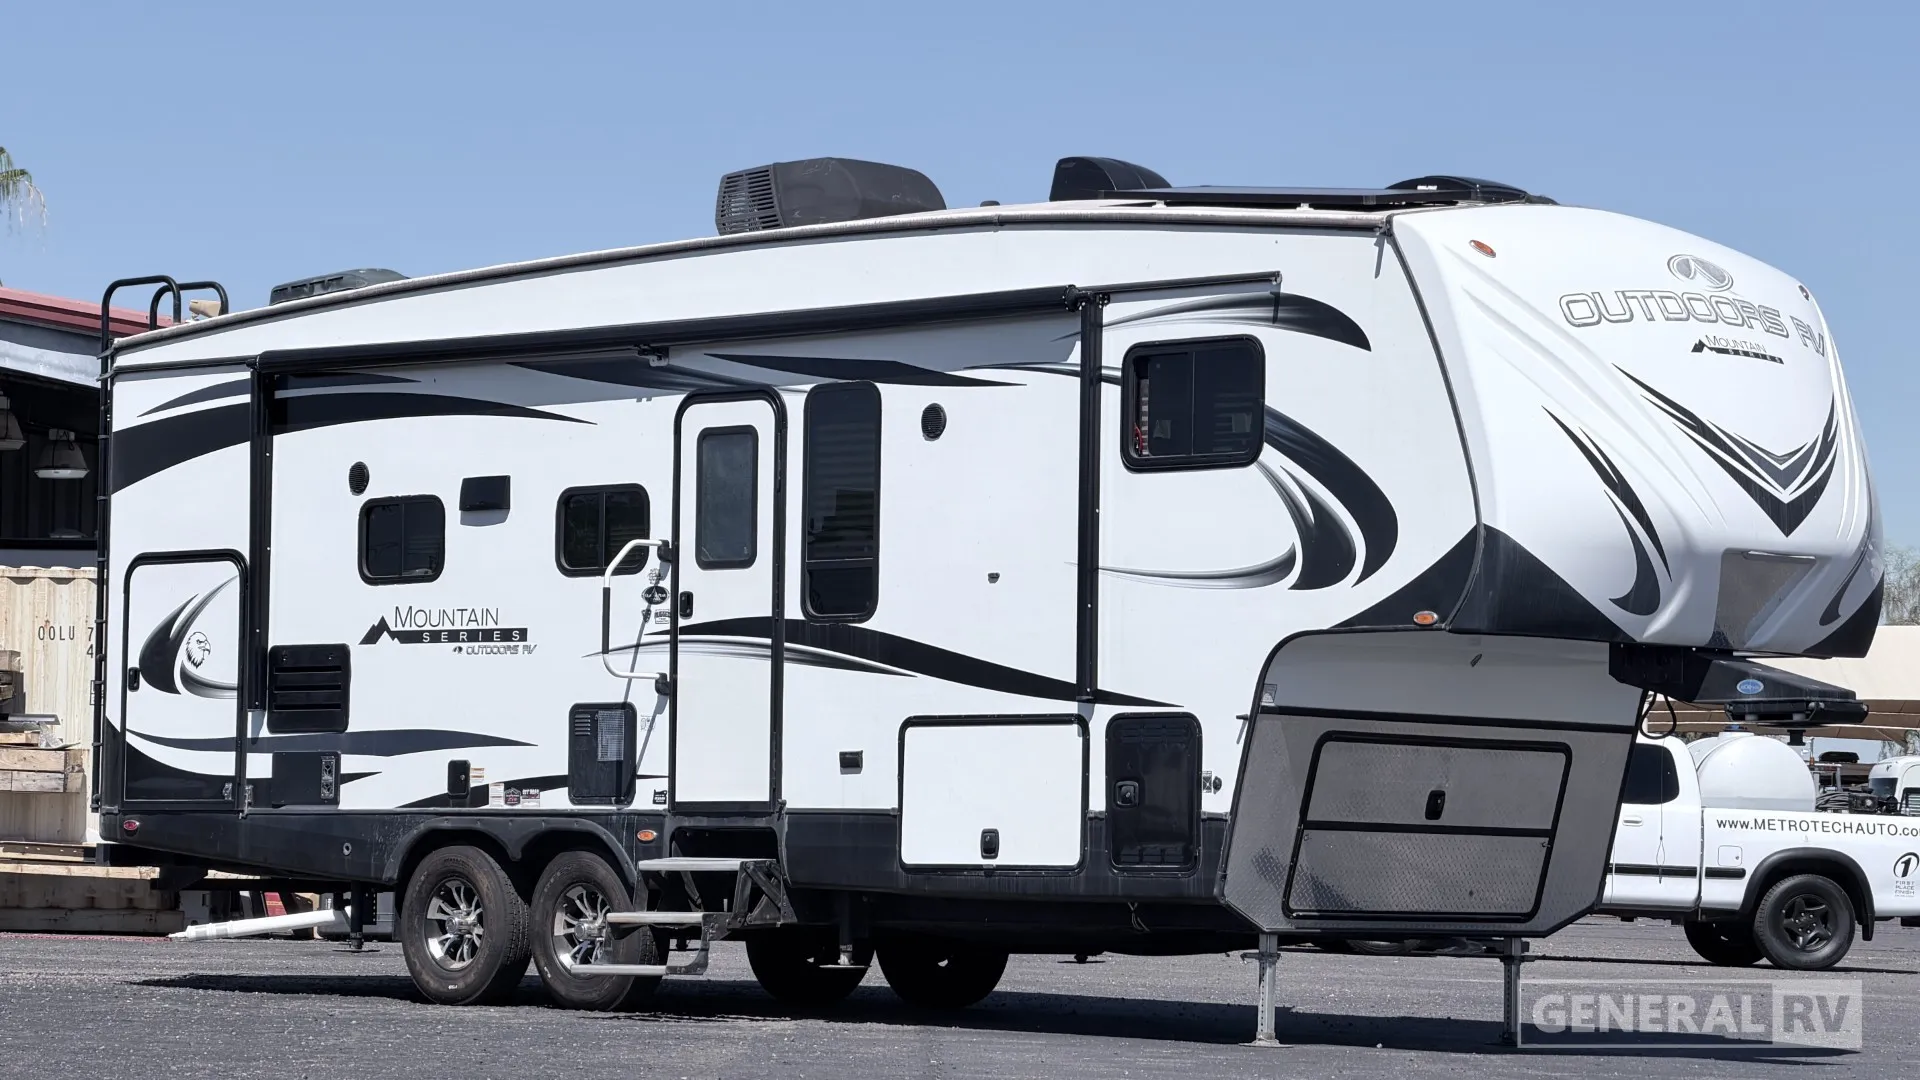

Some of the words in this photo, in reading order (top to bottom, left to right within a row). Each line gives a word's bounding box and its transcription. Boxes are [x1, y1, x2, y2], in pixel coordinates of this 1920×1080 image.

[1559, 289, 1789, 339] OUTDOORS
[1789, 315, 1825, 357] RV
[1728, 348, 1781, 363] SERIES
[422, 630, 520, 643] SERIES
[466, 644, 520, 655] OUTDOORS
[522, 643, 538, 655] RV
[1716, 818, 1920, 838] www.METROTECHAUTO.co
